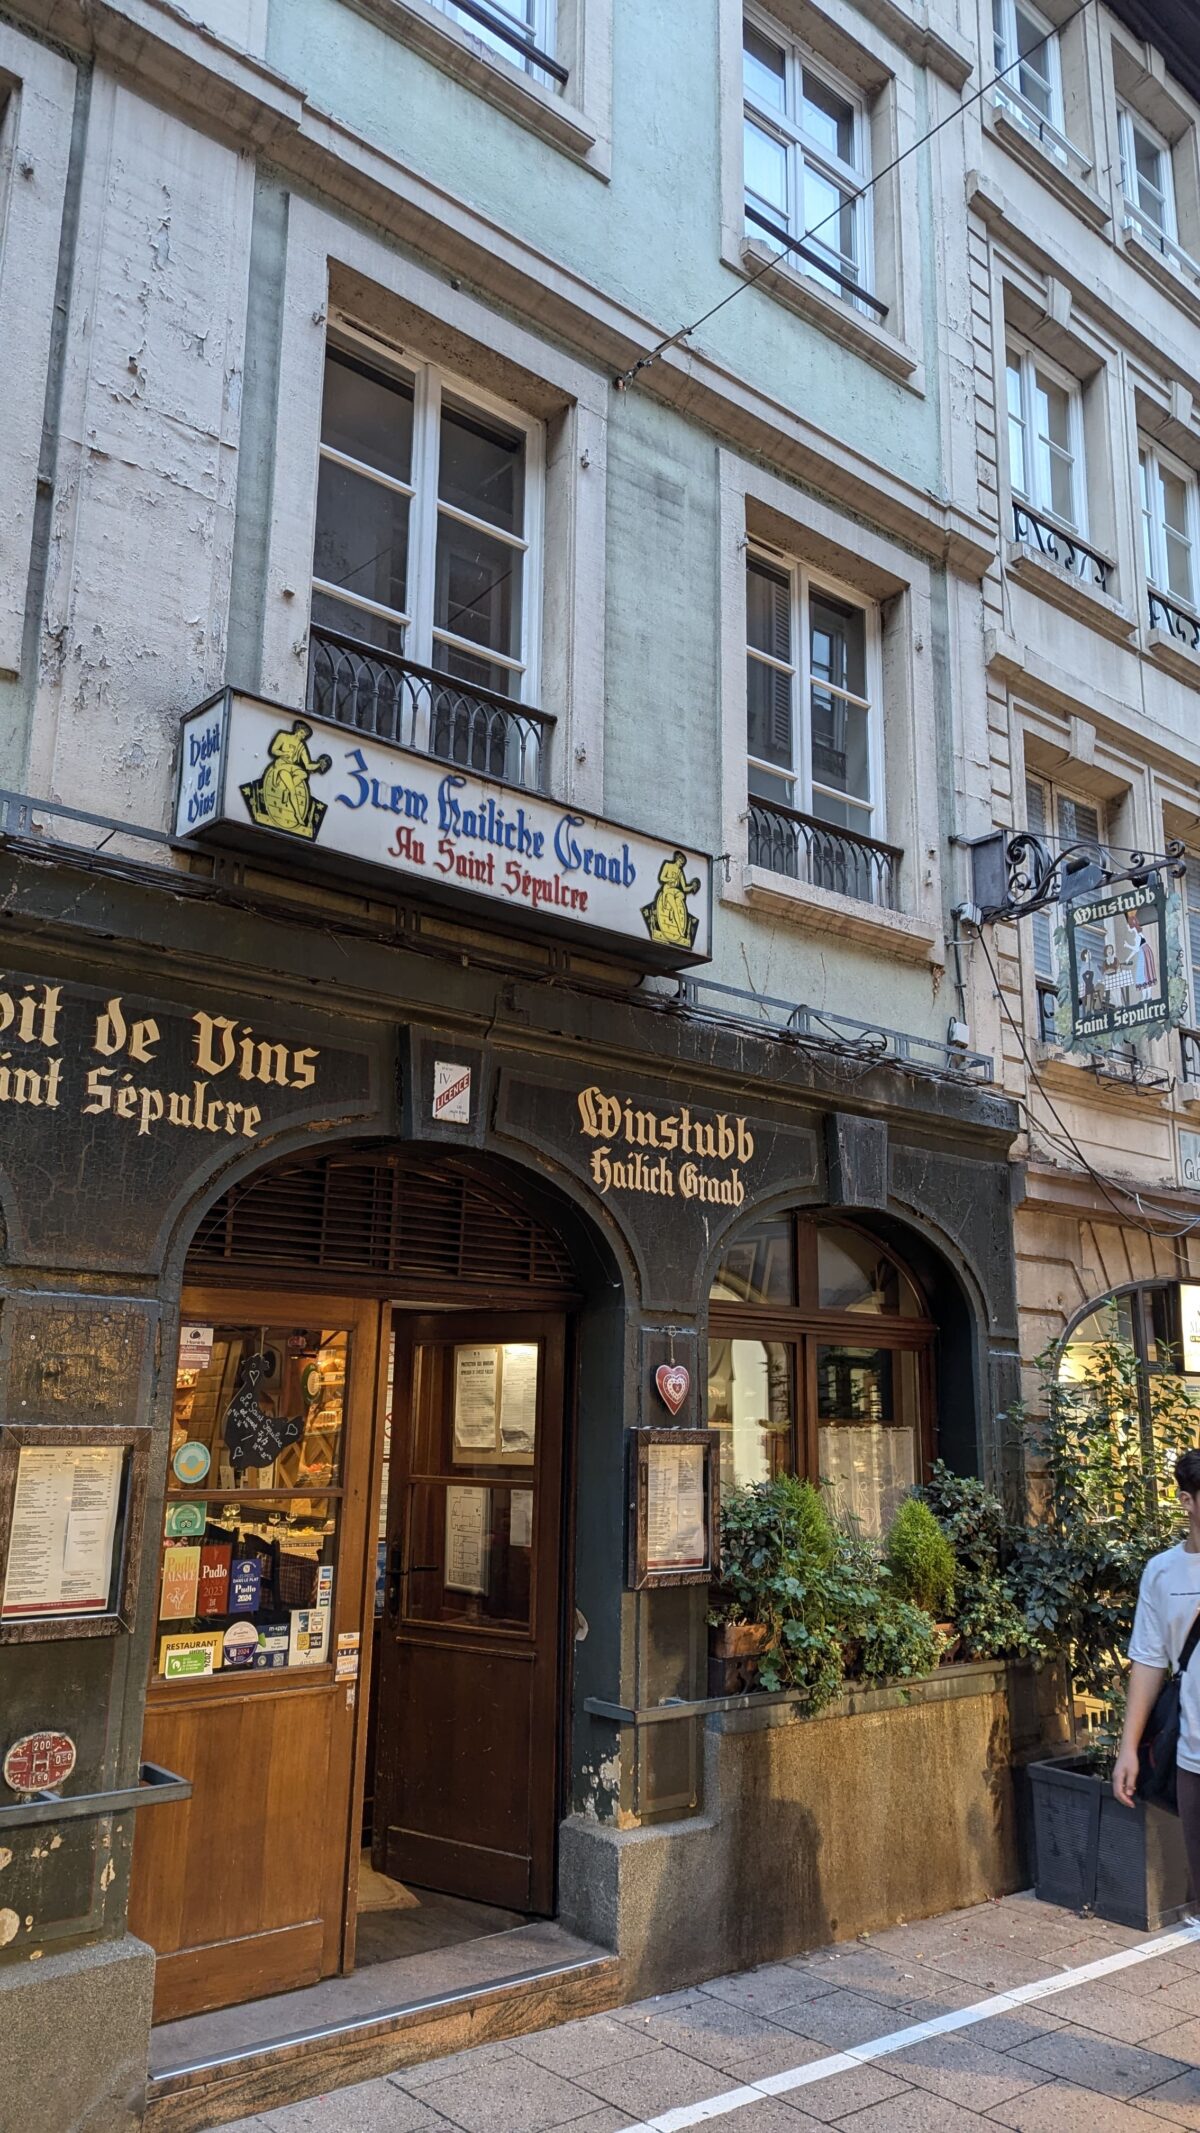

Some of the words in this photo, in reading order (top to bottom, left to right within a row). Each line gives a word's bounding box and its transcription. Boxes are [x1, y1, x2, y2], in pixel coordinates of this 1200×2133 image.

[189, 723, 220, 767] Débit
[197, 762, 212, 790] de
[438, 774, 545, 859] Hailiche
[554, 813, 636, 888] Graab
[388, 826, 425, 865] Au
[433, 838, 495, 886] Saint
[501, 860, 588, 912] Sépulcre
[1073, 888, 1156, 926] Winstubb
[1075, 1014, 1109, 1036] Saint
[1113, 1002, 1167, 1027] Sépulcre
[94, 997, 161, 1063] de
[192, 1010, 321, 1090] Vins
[82, 1066, 262, 1138] Sépulcre
[437, 1075, 469, 1110] LICENCE
[577, 1086, 754, 1164] Winstubb
[591, 1146, 675, 1197] Hailich
[679, 1161, 745, 1208] Graab
[202, 1564, 227, 1579] Pudlo
[203, 1586, 224, 1597] 2023
[234, 1584, 256, 1594] Pudlo
[237, 1594, 252, 1603] 2024
[166, 1639, 218, 1651] RESTAURANT
[32, 1751, 51, 1773] H
[33, 1740, 51, 1752] 200
